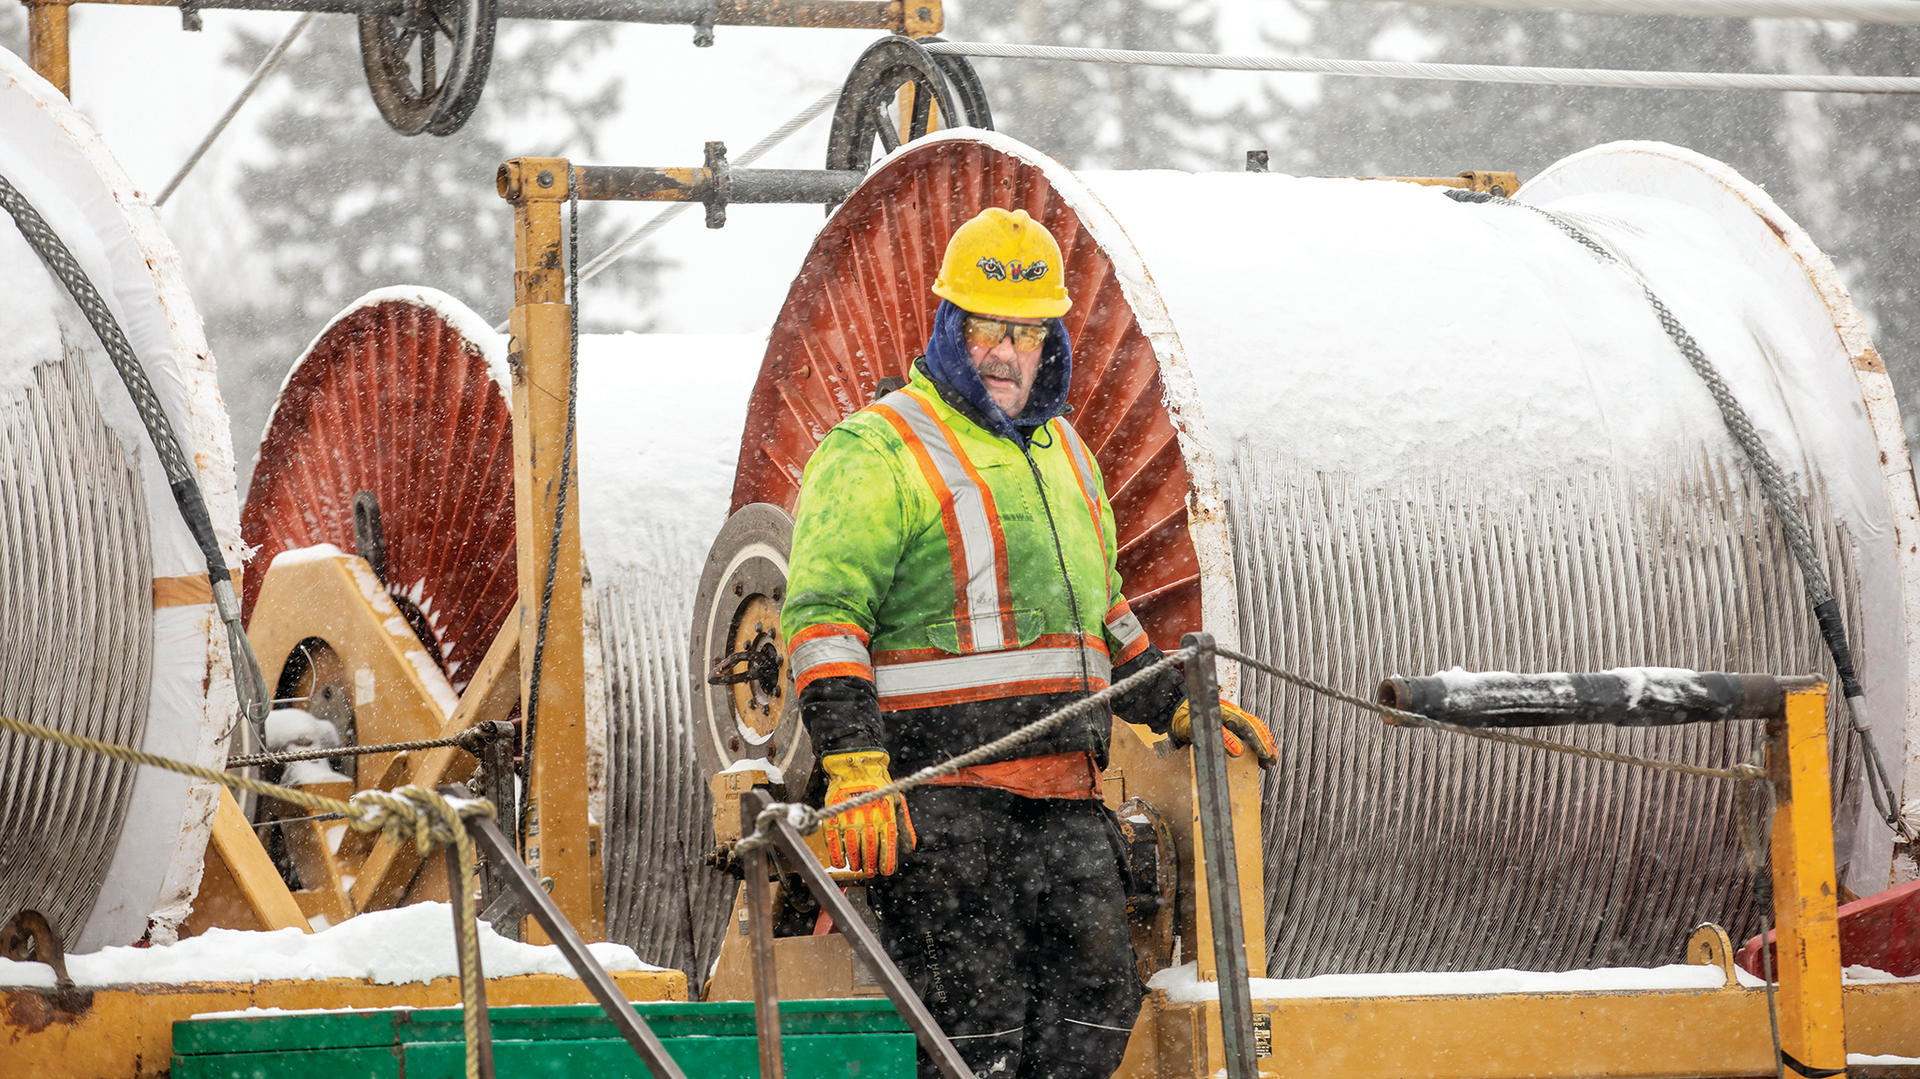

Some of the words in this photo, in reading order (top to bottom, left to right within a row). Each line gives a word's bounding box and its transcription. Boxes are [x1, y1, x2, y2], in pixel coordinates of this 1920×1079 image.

[723, 774, 741, 791] TSE
[925, 931, 937, 960] HELLY
[932, 963, 948, 1003] HANSEN
